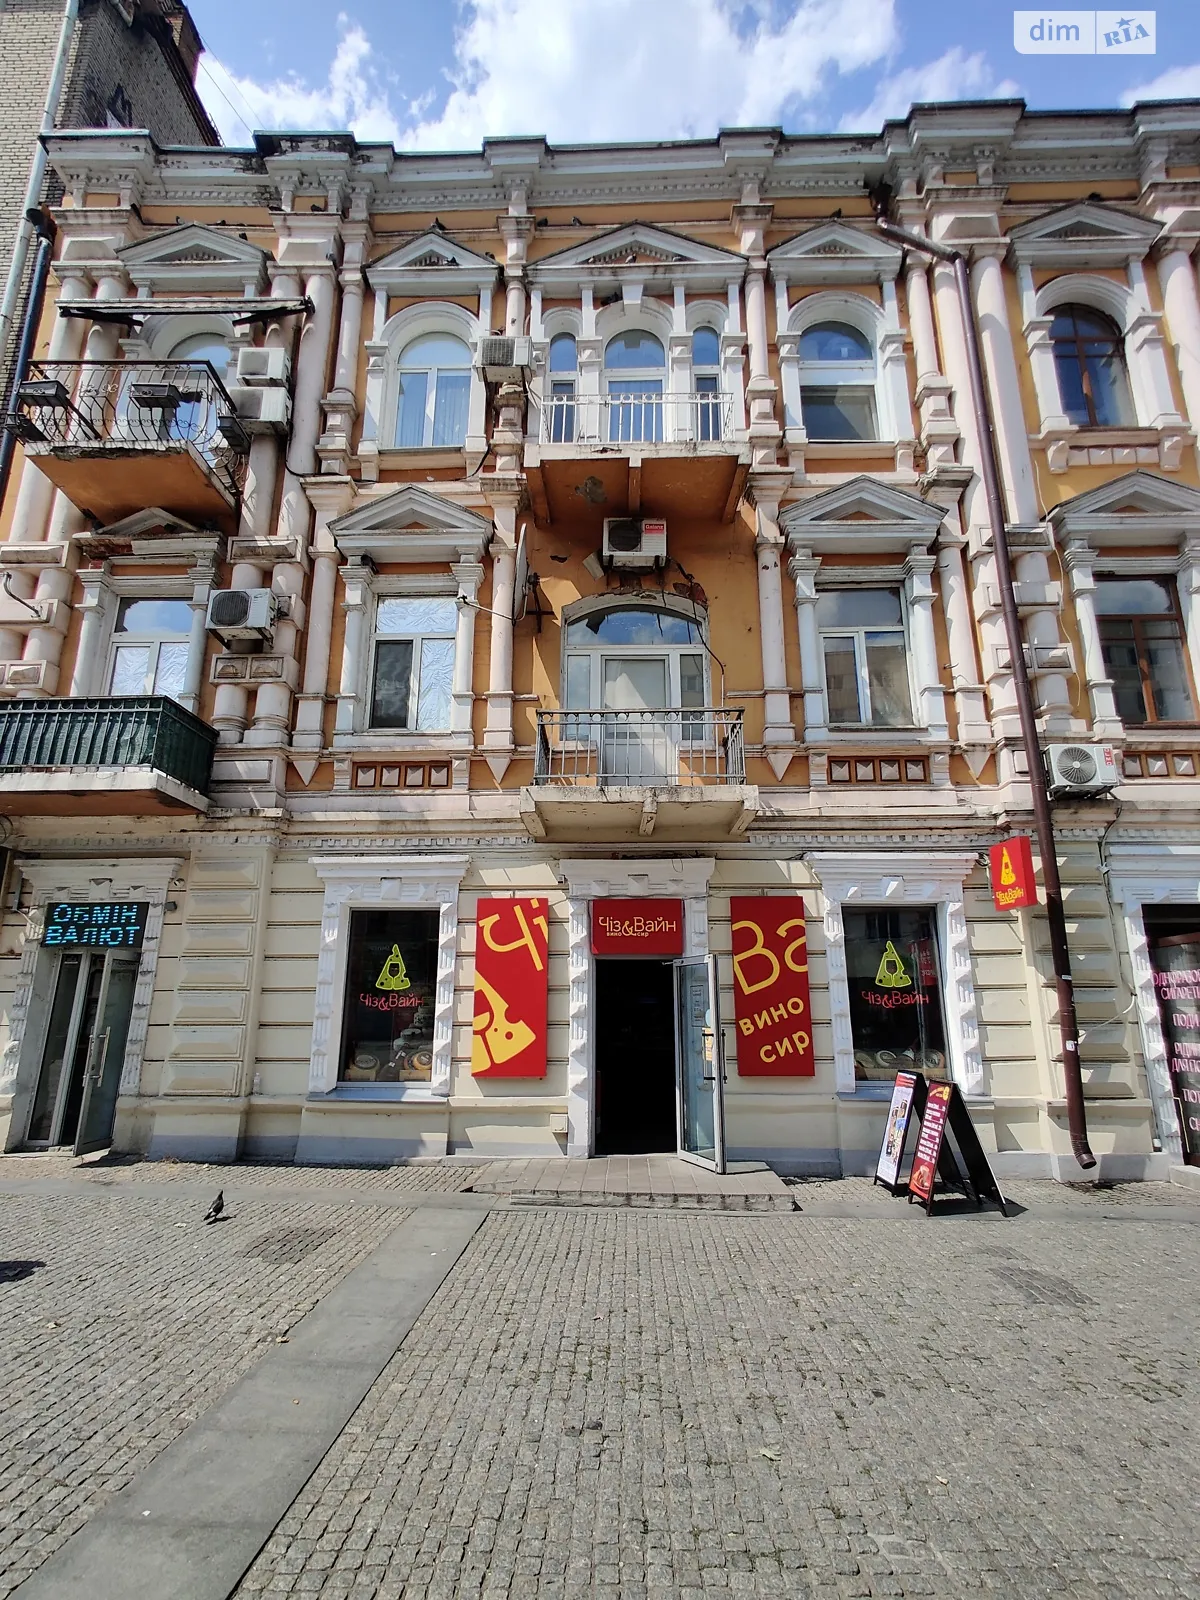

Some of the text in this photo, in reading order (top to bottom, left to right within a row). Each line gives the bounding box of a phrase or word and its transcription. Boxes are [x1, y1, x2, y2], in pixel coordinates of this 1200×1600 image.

[53, 904, 138, 924] ОБМІН
[45, 925, 140, 945] ВАЛЮТ
[598, 916, 677, 937] Чіз&Вайн
[360, 993, 424, 1011] Чіз&Вайн
[861, 990, 930, 1009] Чіз&Вайн
[738, 997, 805, 1037] вино
[759, 1030, 810, 1063] сир
